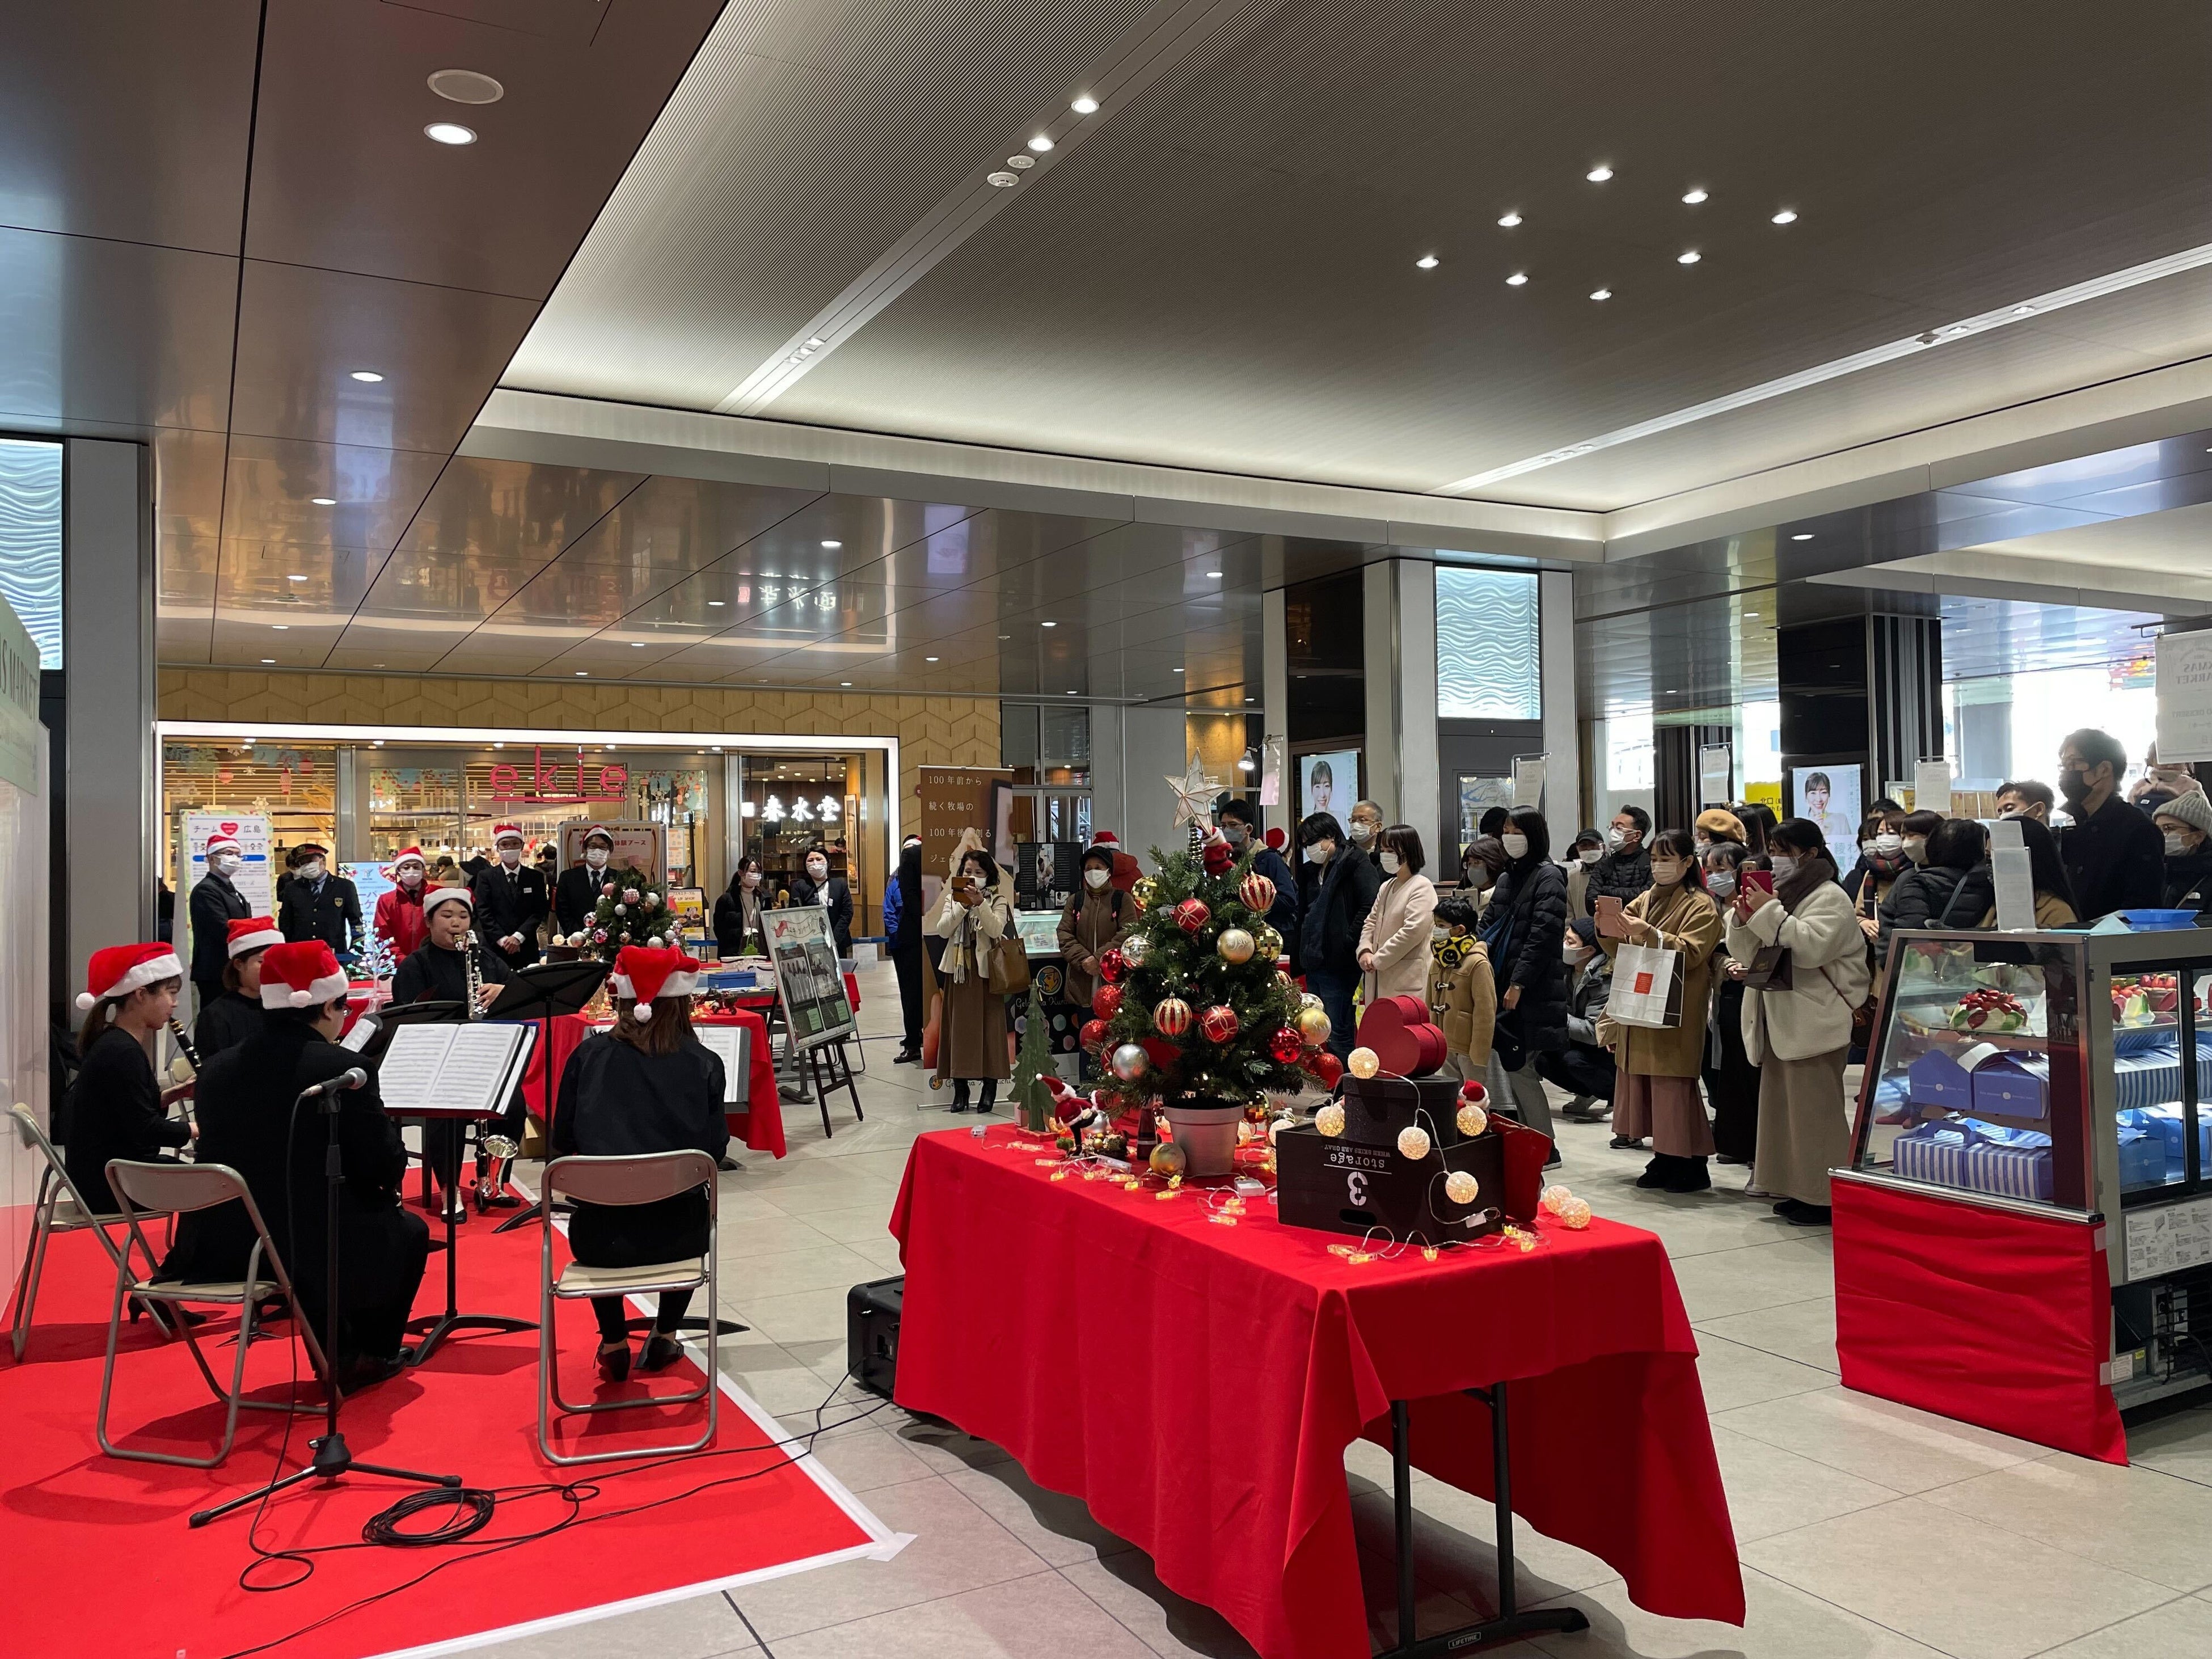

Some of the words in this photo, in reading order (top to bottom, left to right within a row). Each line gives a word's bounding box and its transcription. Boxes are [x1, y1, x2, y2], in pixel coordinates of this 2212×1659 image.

[489, 745, 627, 792] ekie
[761, 794, 841, 822] 春水堂
[928, 800, 974, 812] 続く牧場の
[243, 825, 261, 834] 広島
[1331, 1152, 1384, 1168] storage
[1347, 1171, 1368, 1206] 3
